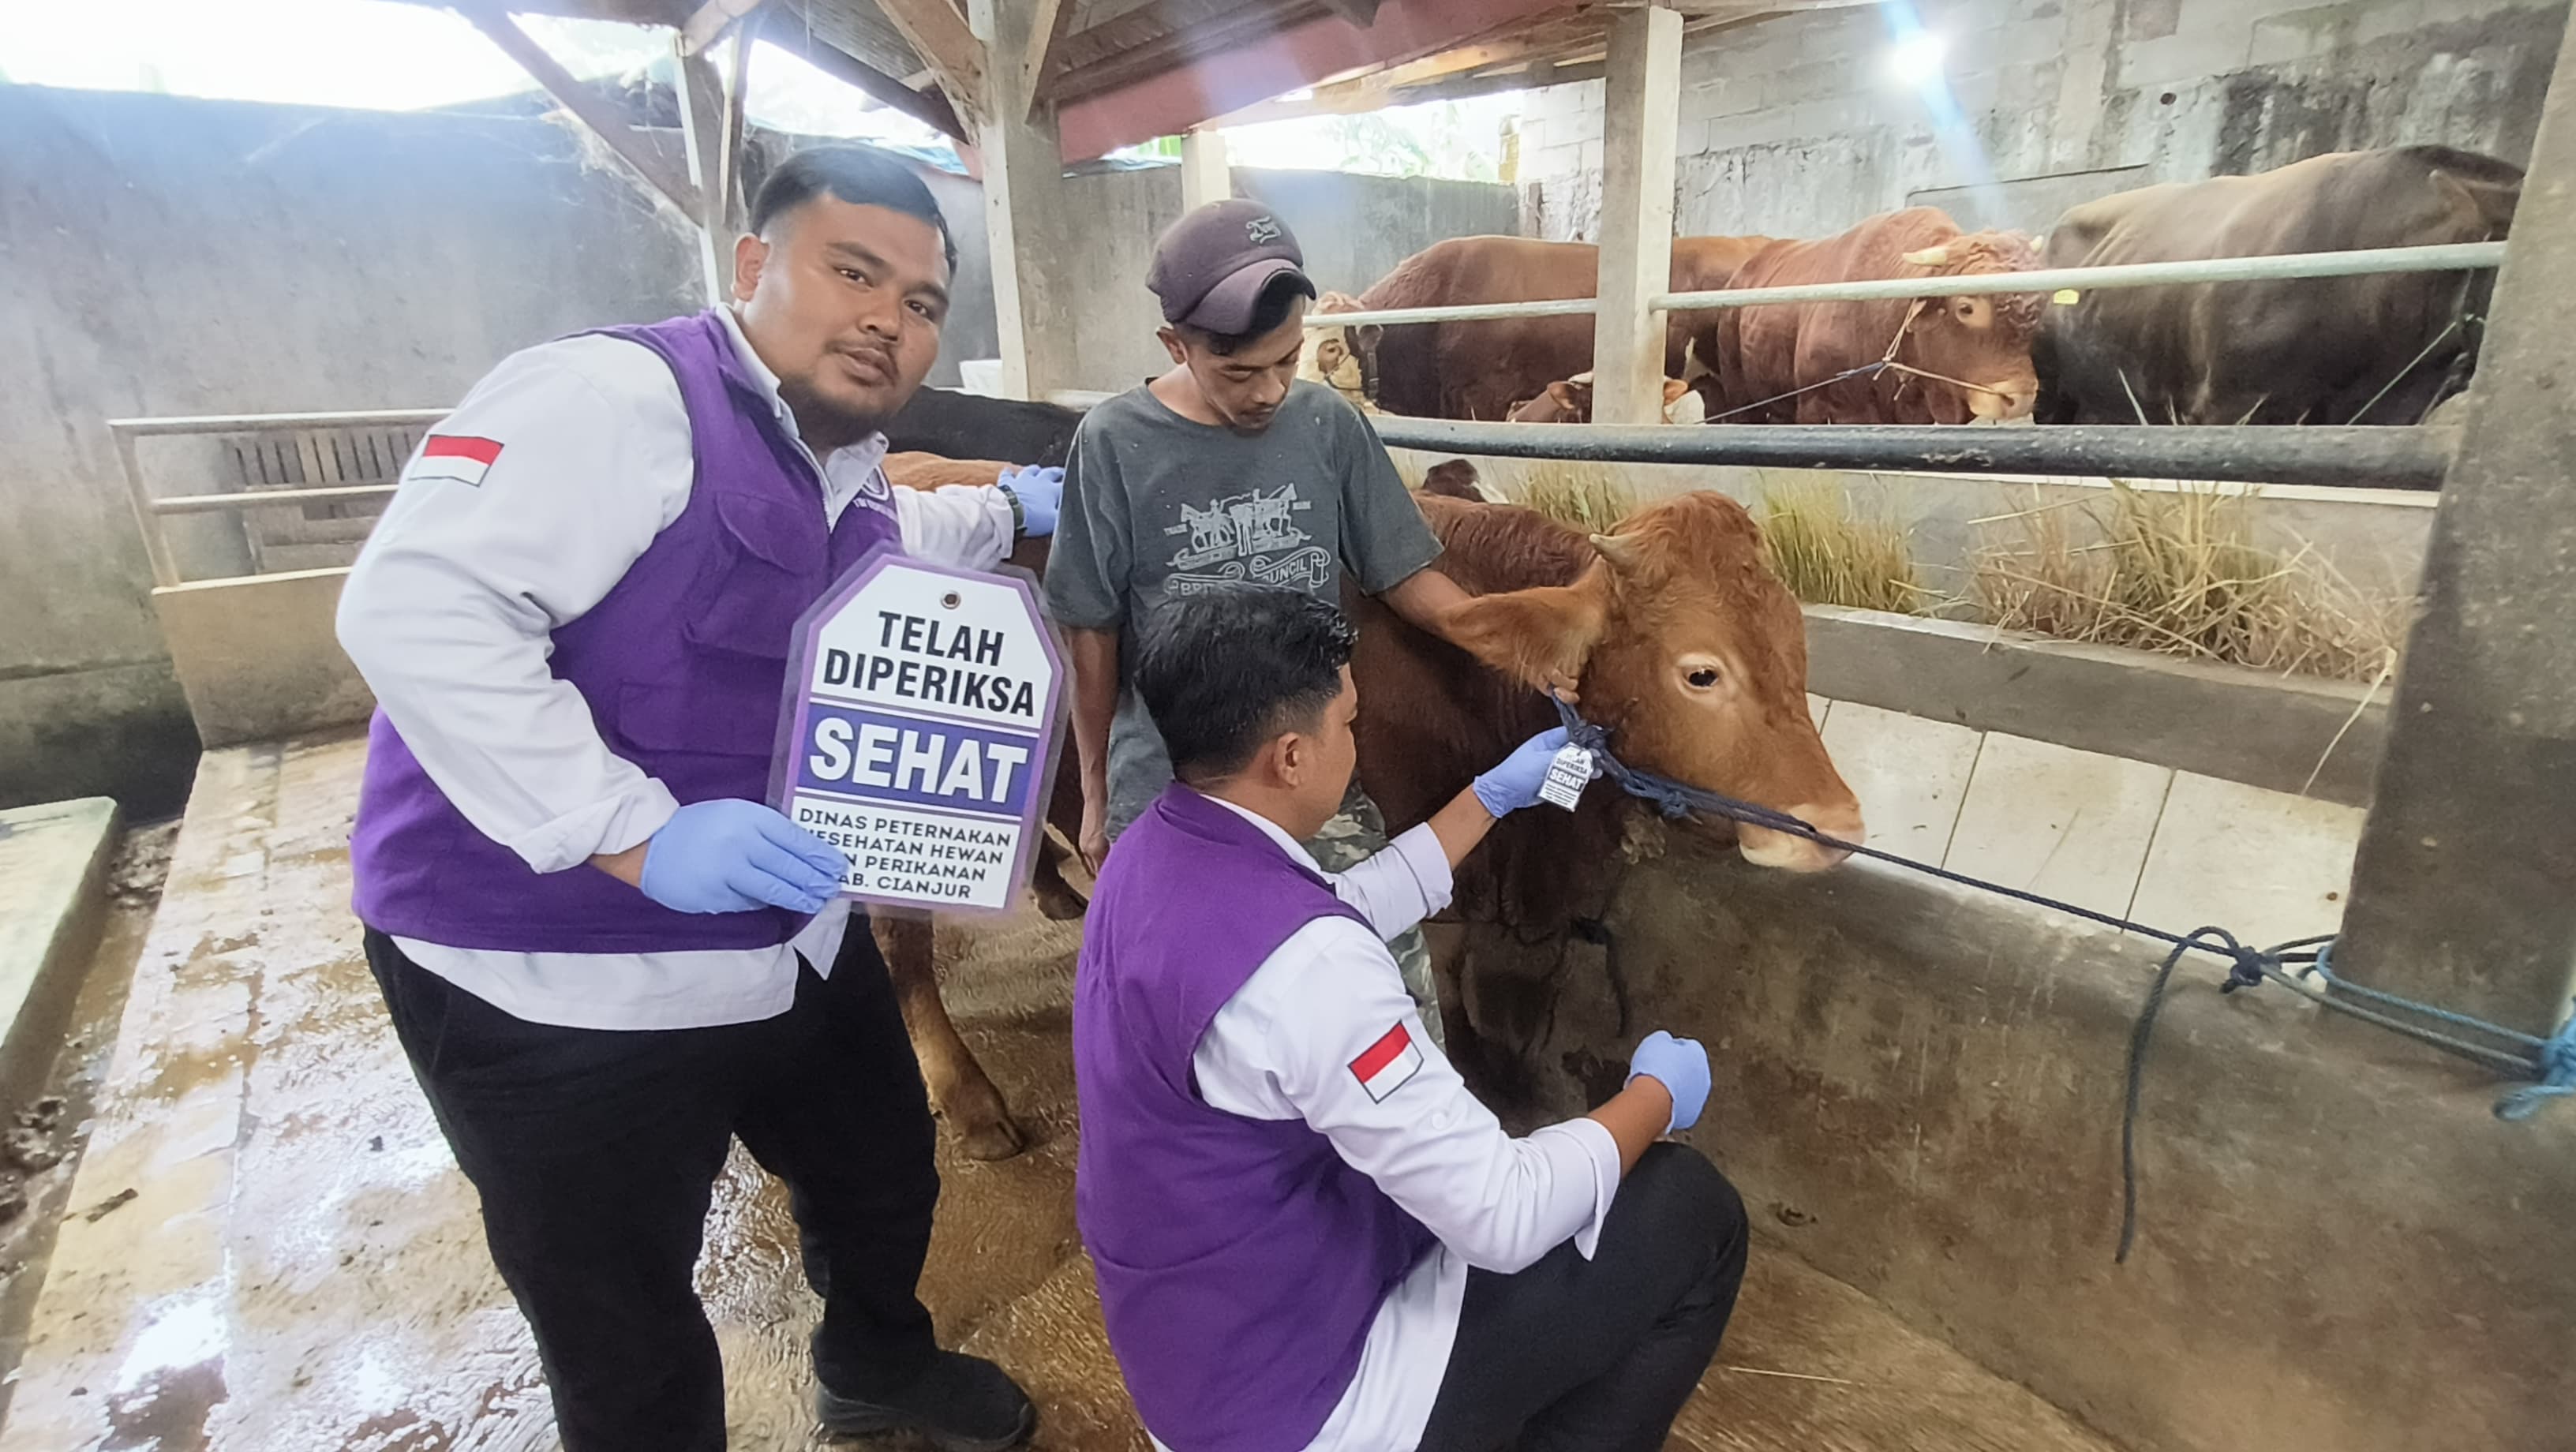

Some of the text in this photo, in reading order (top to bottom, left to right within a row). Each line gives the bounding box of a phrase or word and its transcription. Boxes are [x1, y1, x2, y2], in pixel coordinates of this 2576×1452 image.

[878, 610, 1005, 667] TELAH
[823, 648, 1034, 717] DIPERIKSA
[809, 717, 1029, 804] SEHAT
[1549, 768, 1585, 790] SEHAT
[799, 807, 1011, 847] DINAS PETERNAKAN
[802, 828, 1004, 865] ESEHATAN HEWAN
[838, 872, 972, 899] AB. CIANJUR
[865, 855, 987, 881] PERIKANAN
